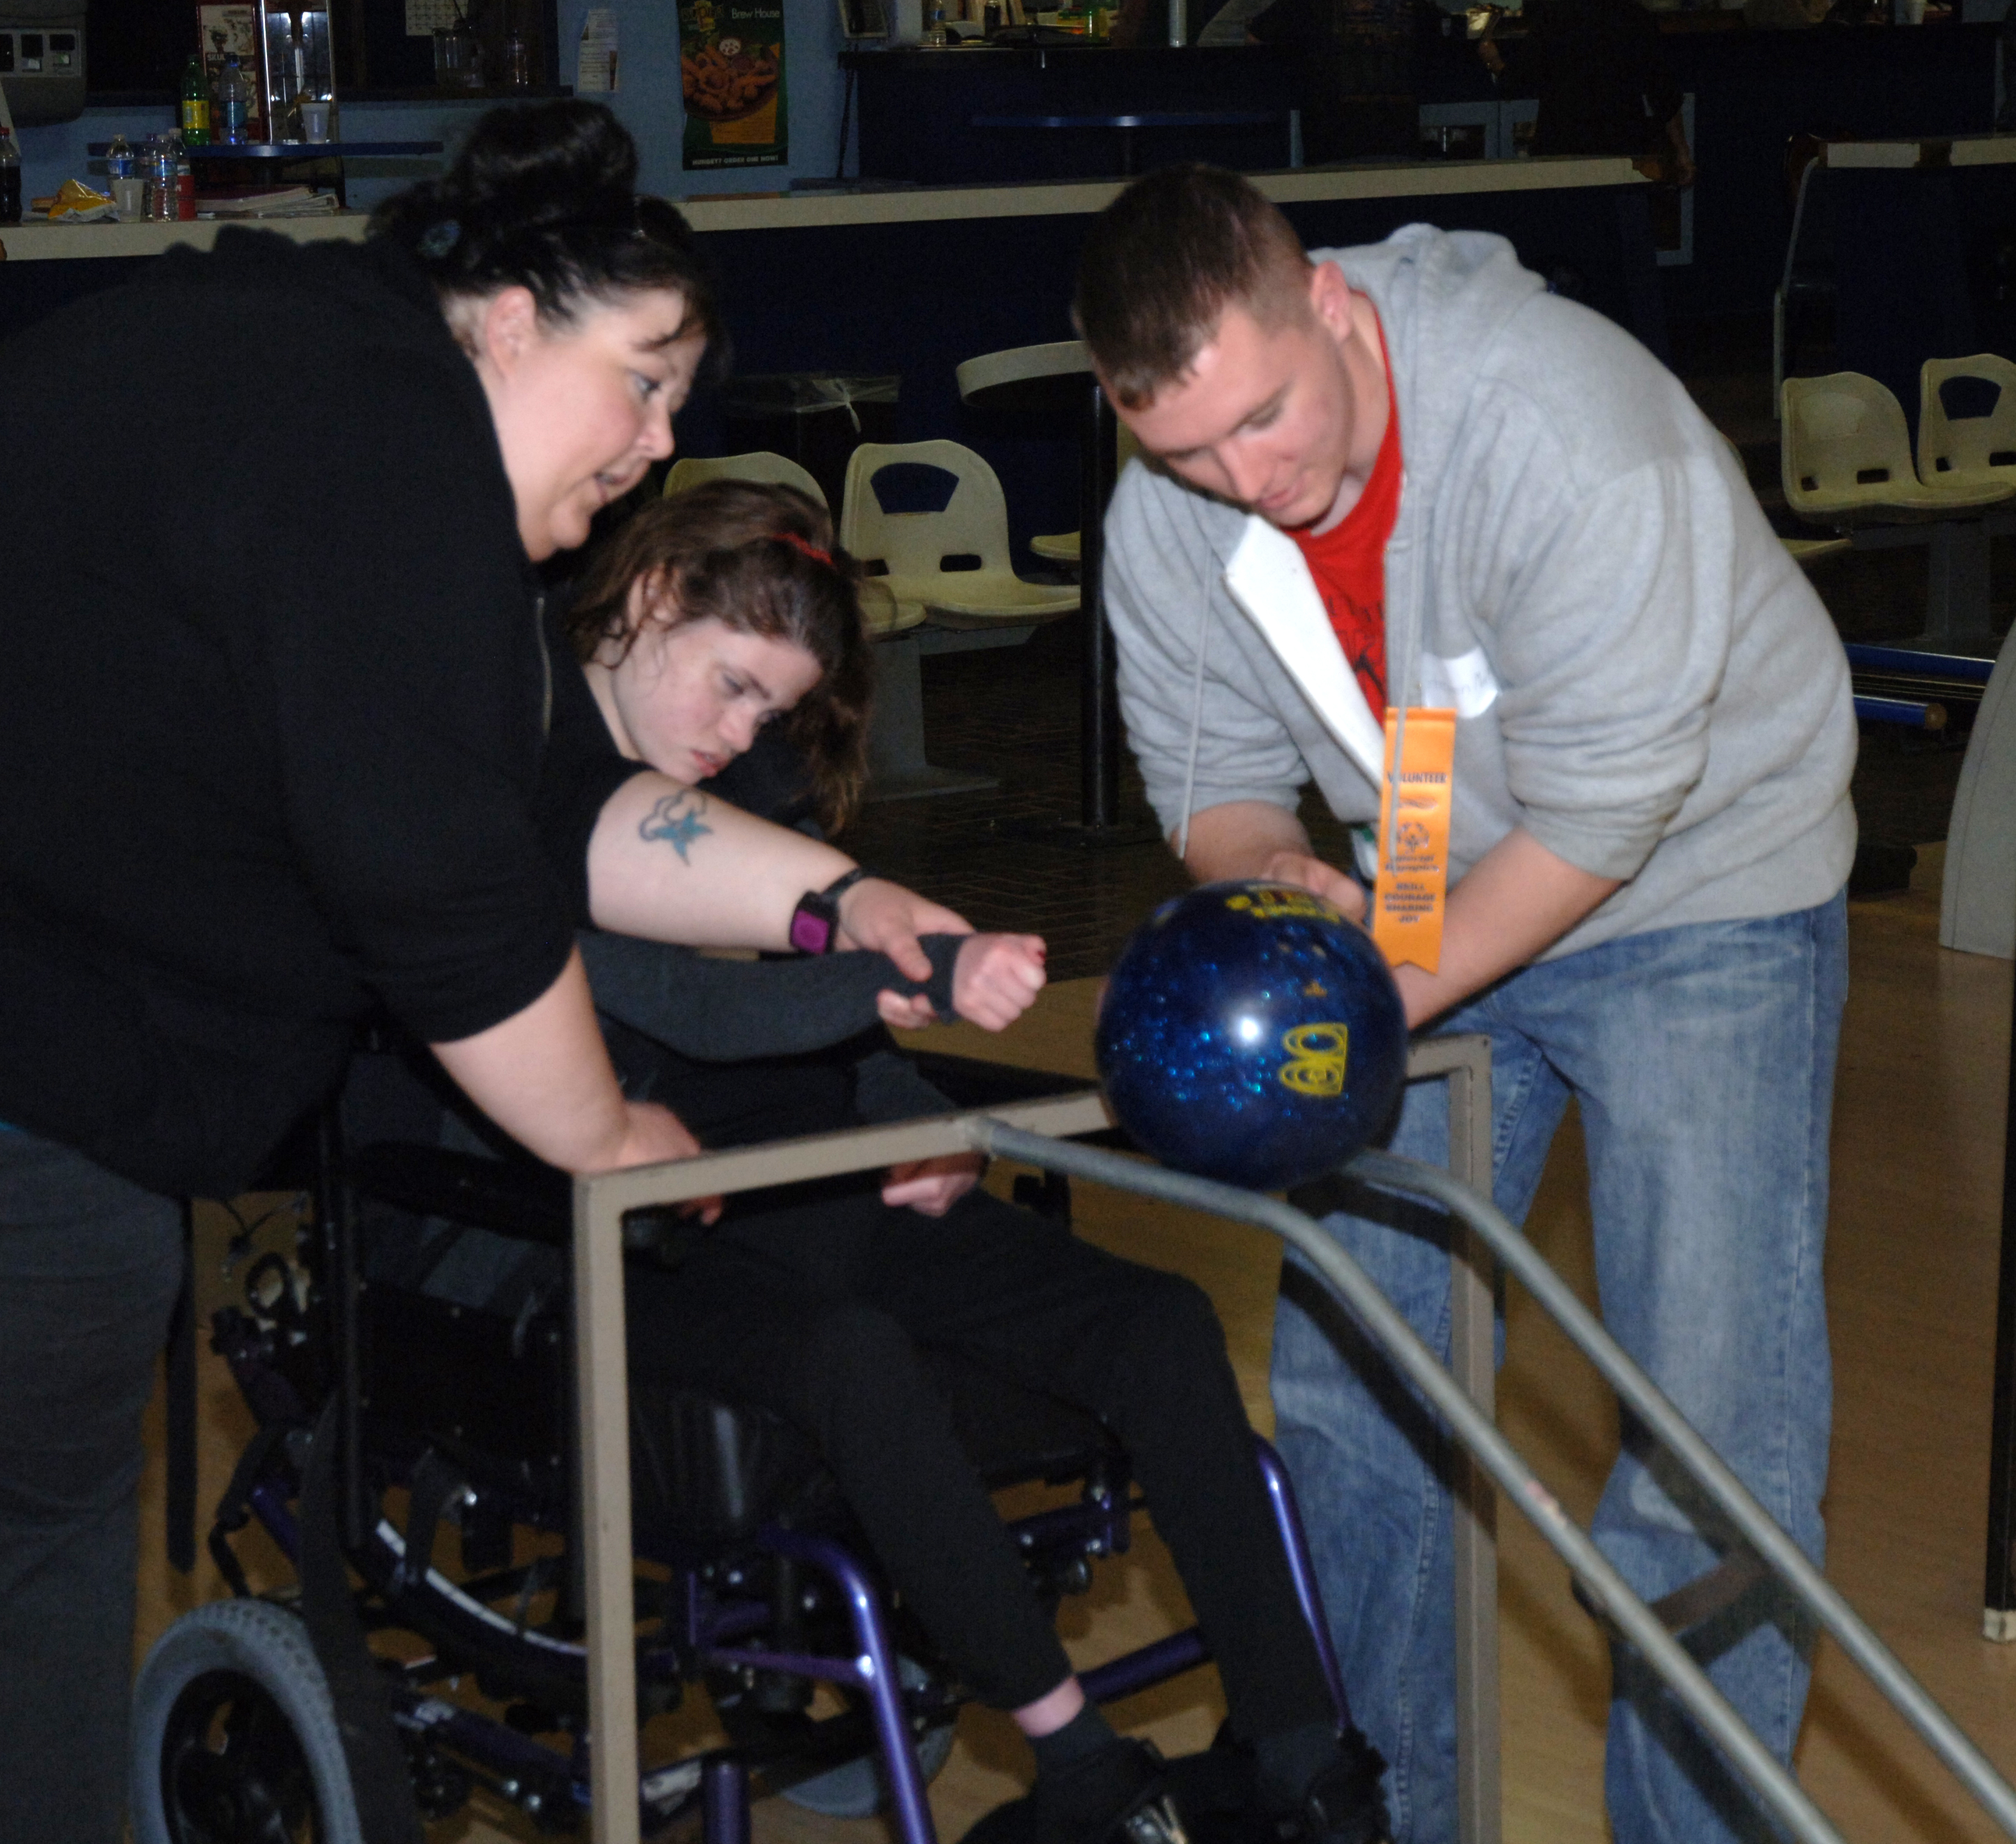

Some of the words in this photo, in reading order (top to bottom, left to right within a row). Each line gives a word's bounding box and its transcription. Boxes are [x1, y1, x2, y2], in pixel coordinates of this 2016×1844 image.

[732, 8, 753, 18] Brew
[754, 7, 780, 18] House
[1387, 771, 1447, 784] VLUNTEER
[1398, 915, 1419, 923] JOY
